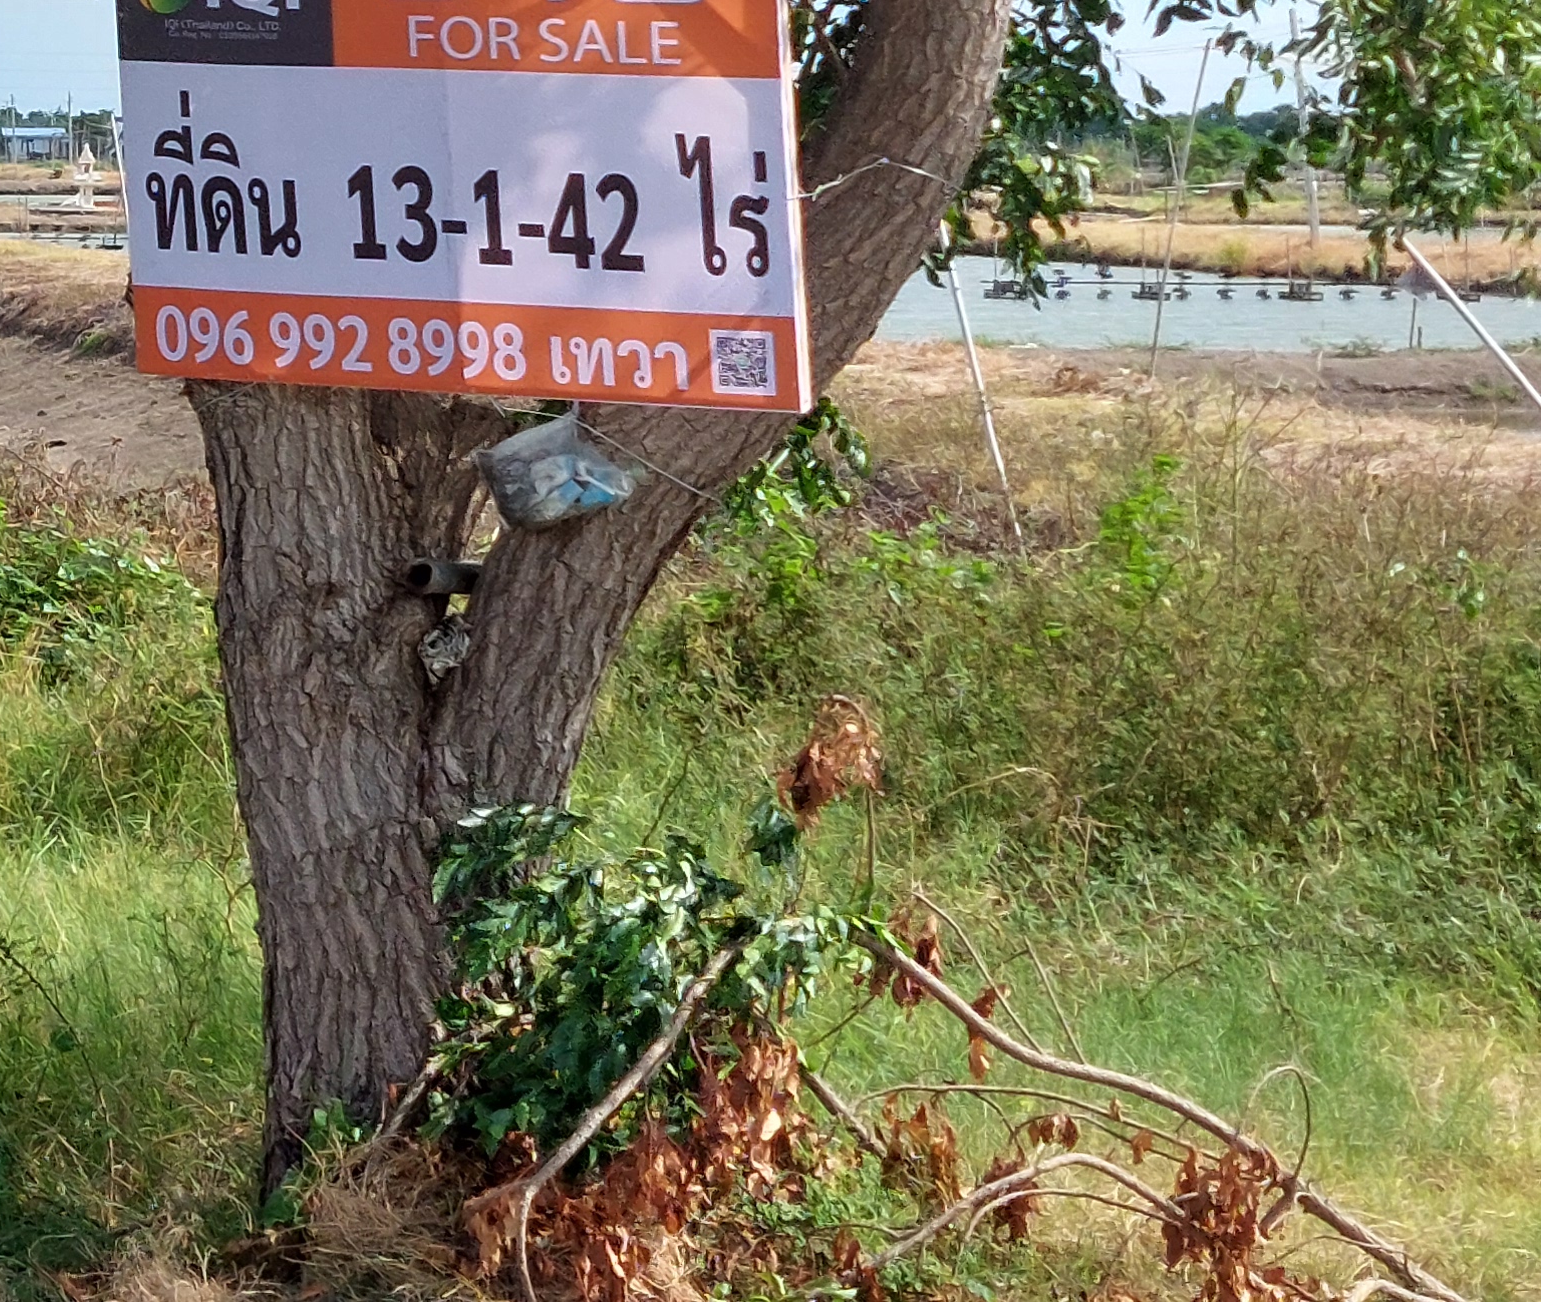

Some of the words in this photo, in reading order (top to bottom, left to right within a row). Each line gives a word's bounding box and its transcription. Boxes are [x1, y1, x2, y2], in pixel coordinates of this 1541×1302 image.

[407, 14, 521, 60] FOR
[538, 18, 683, 66] SALE
[145, 89, 302, 259] ที่ดิน
[347, 164, 646, 274] 13-1-42
[674, 132, 770, 278] ไร่
[155, 304, 255, 366] 096
[269, 311, 374, 372] 992
[387, 316, 527, 381] 8998
[549, 335, 689, 390] เทวา
